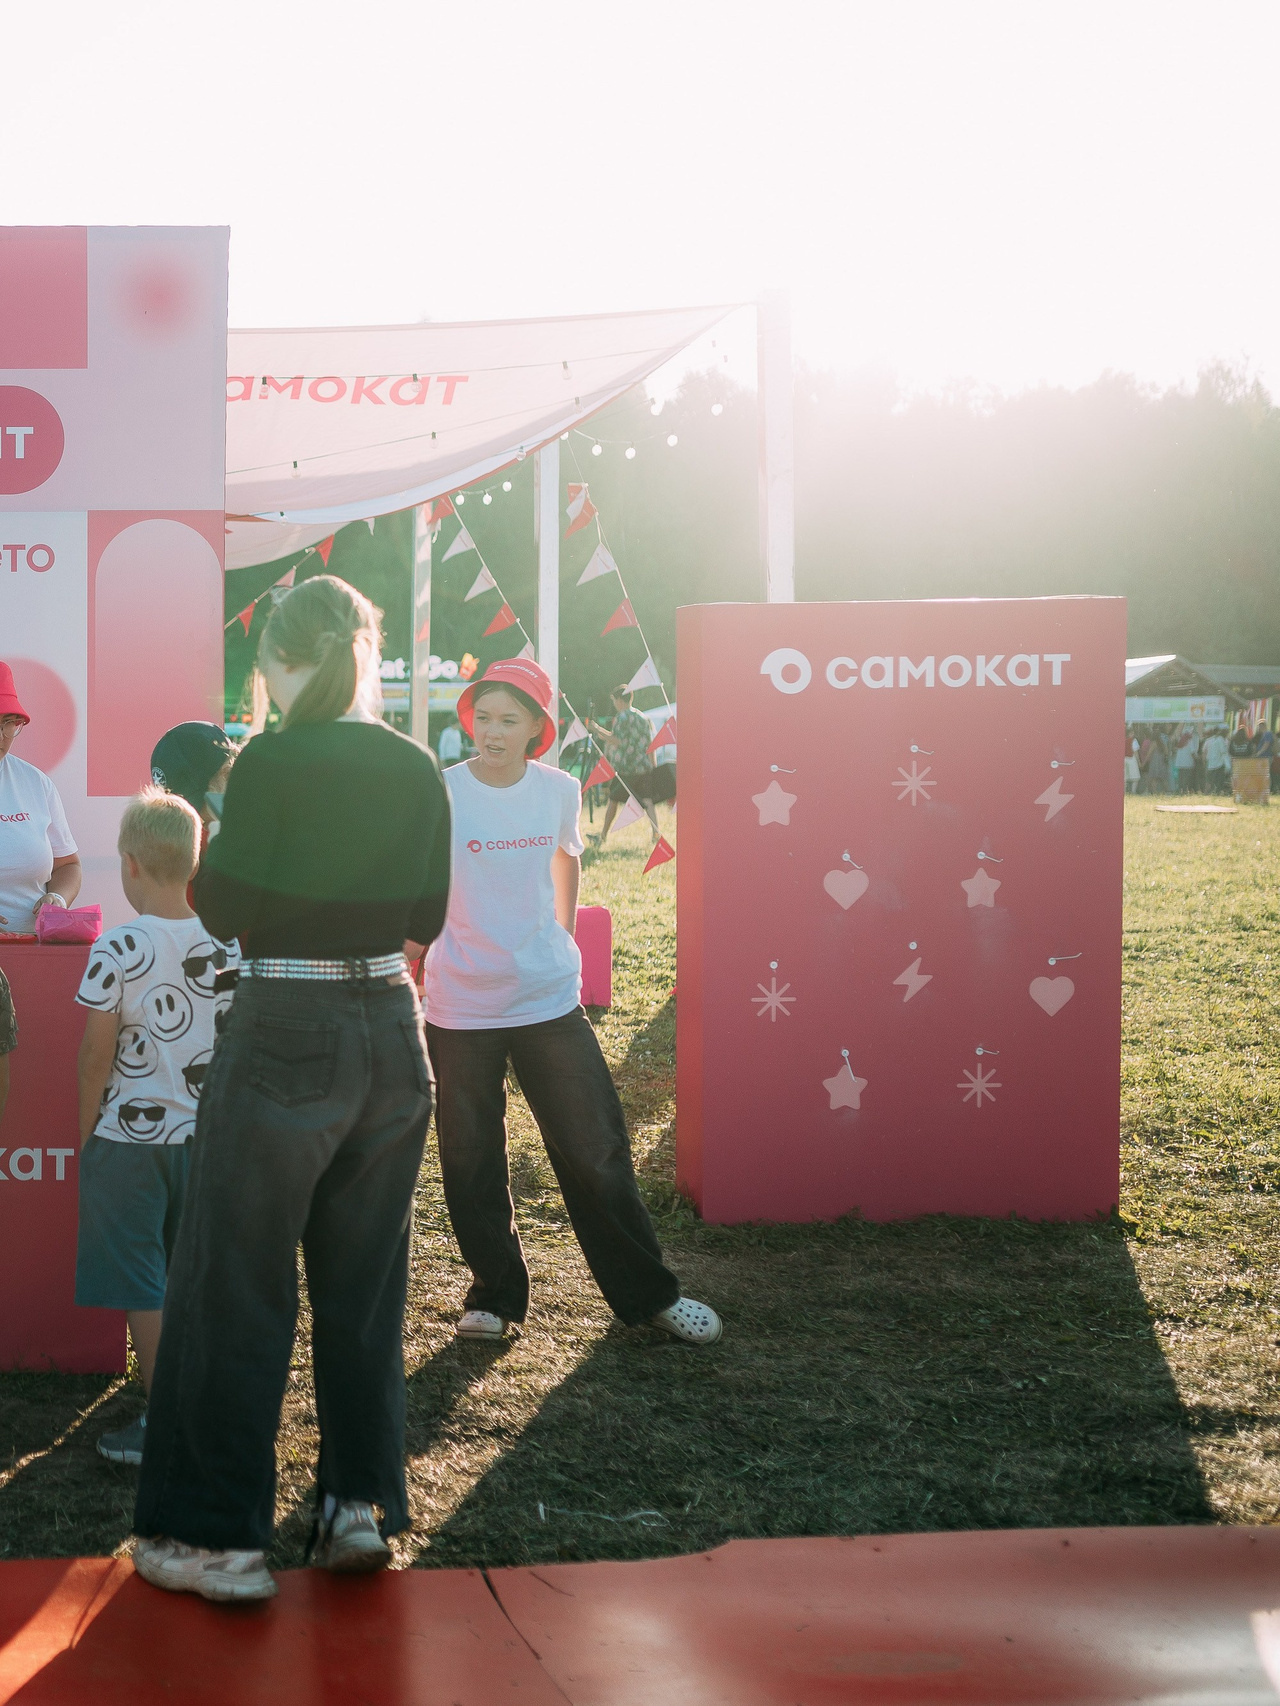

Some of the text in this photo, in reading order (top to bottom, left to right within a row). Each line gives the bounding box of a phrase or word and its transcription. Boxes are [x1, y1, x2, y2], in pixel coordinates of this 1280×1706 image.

[227, 374, 470, 406] амокат
[825, 653, 1071, 690] самокат
[485, 835, 554, 851] самокат
